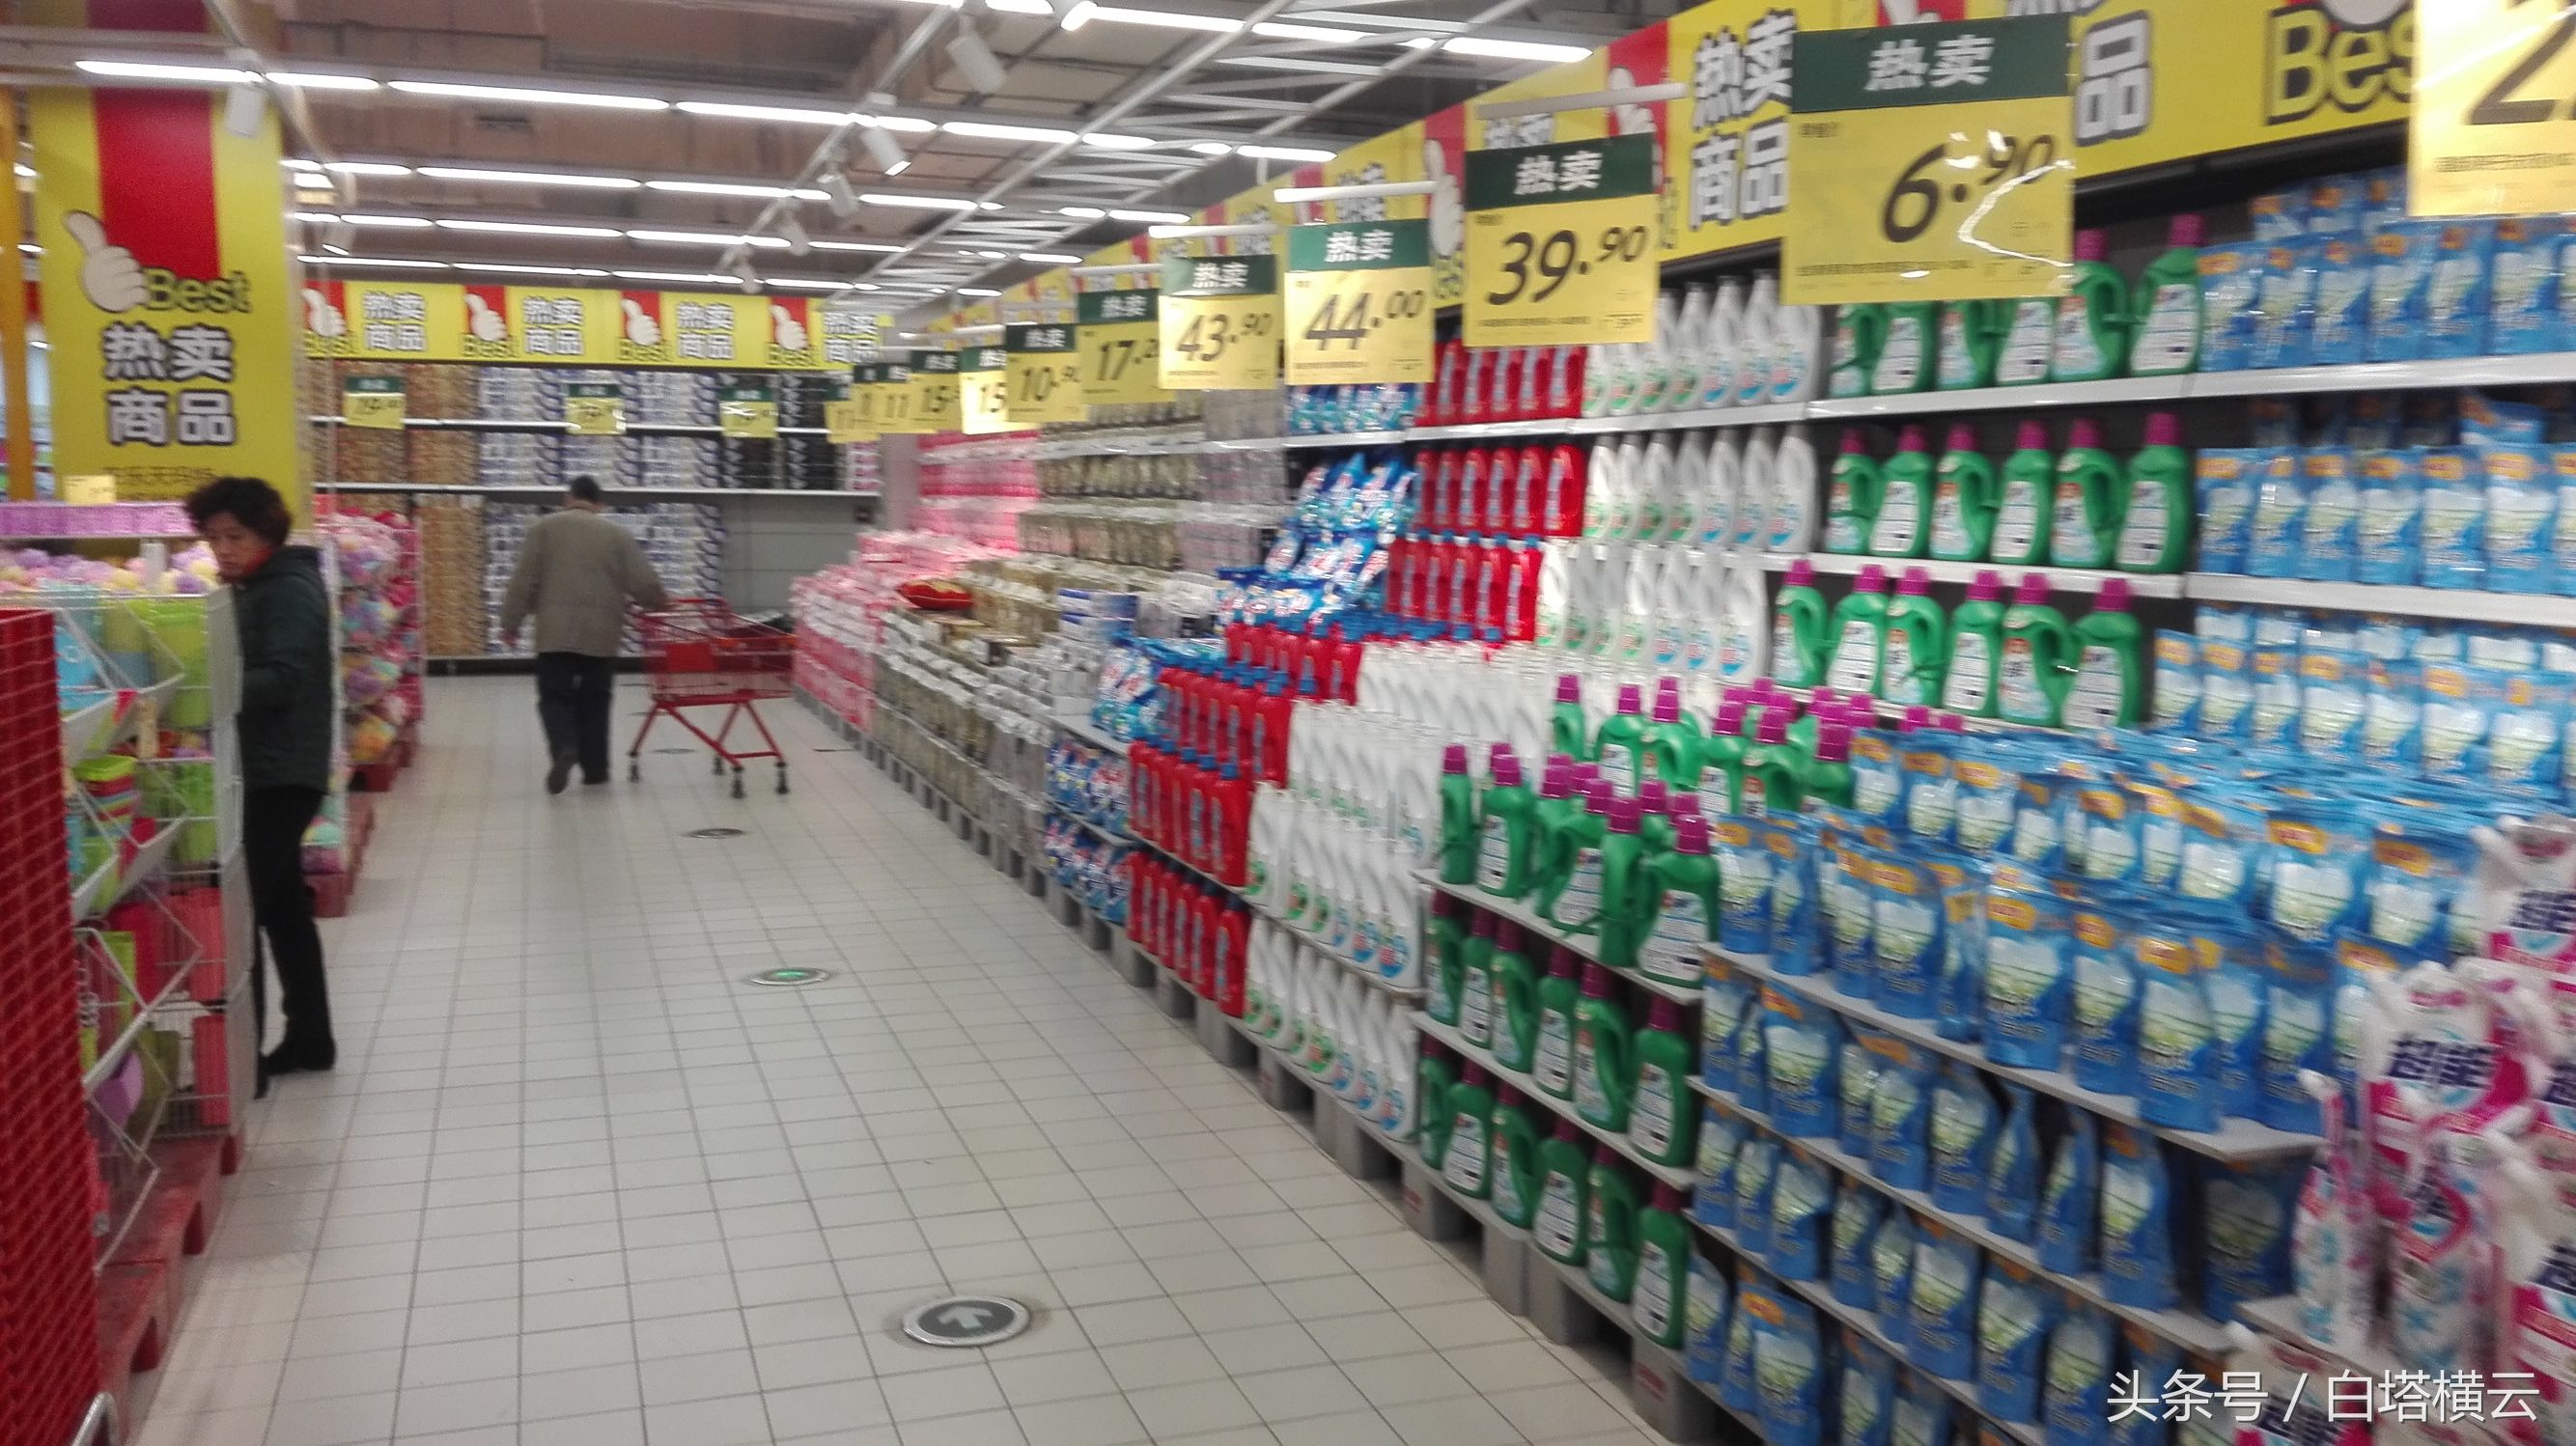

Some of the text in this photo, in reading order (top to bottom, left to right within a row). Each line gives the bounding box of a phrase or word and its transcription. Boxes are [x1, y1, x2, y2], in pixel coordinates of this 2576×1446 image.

[1693, 8, 1796, 131] 热卖
[1863, 34, 1996, 93] 热卖
[2264, 2, 2414, 125] Bes
[1513, 150, 1604, 196] 热卖
[1689, 116, 1788, 232] 商品
[1324, 229, 1394, 264] 热卖
[1486, 226, 1647, 307] 39.90
[144, 266, 253, 314] Best
[1304, 290, 1425, 351] 44.00
[99, 320, 236, 384] 热卖
[104, 384, 238, 447] 商品
